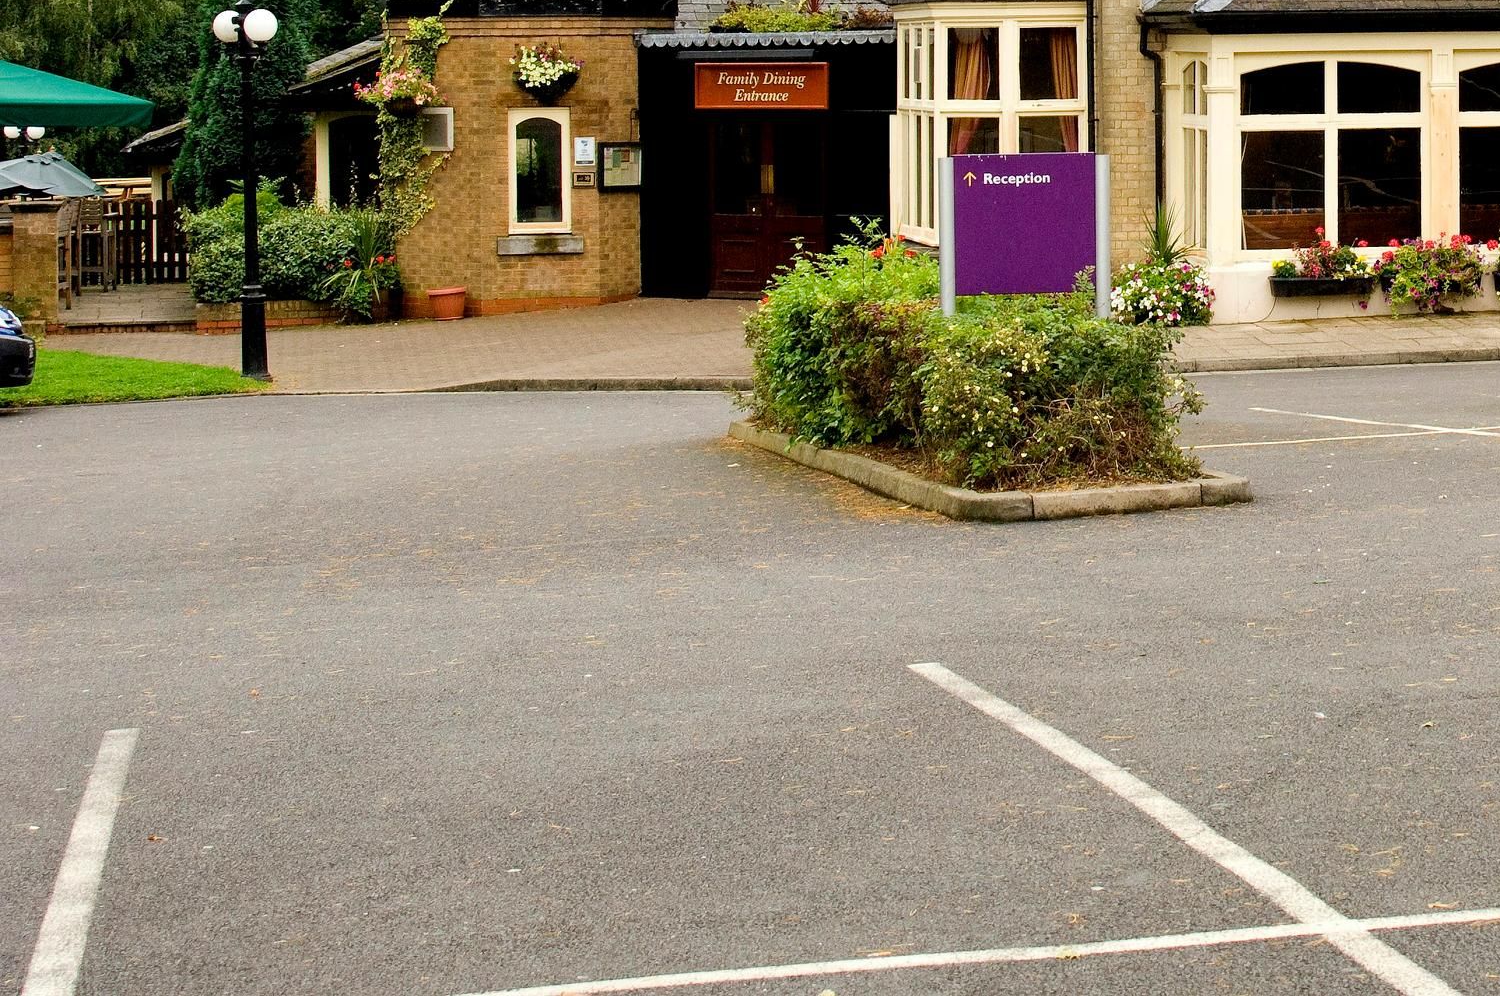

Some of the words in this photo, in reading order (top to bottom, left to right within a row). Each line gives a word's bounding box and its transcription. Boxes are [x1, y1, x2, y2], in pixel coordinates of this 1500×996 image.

[717, 71, 760, 89] Family
[762, 71, 806, 89] Dining
[734, 88, 789, 102] Entrance
[983, 171, 1051, 188] Reception
